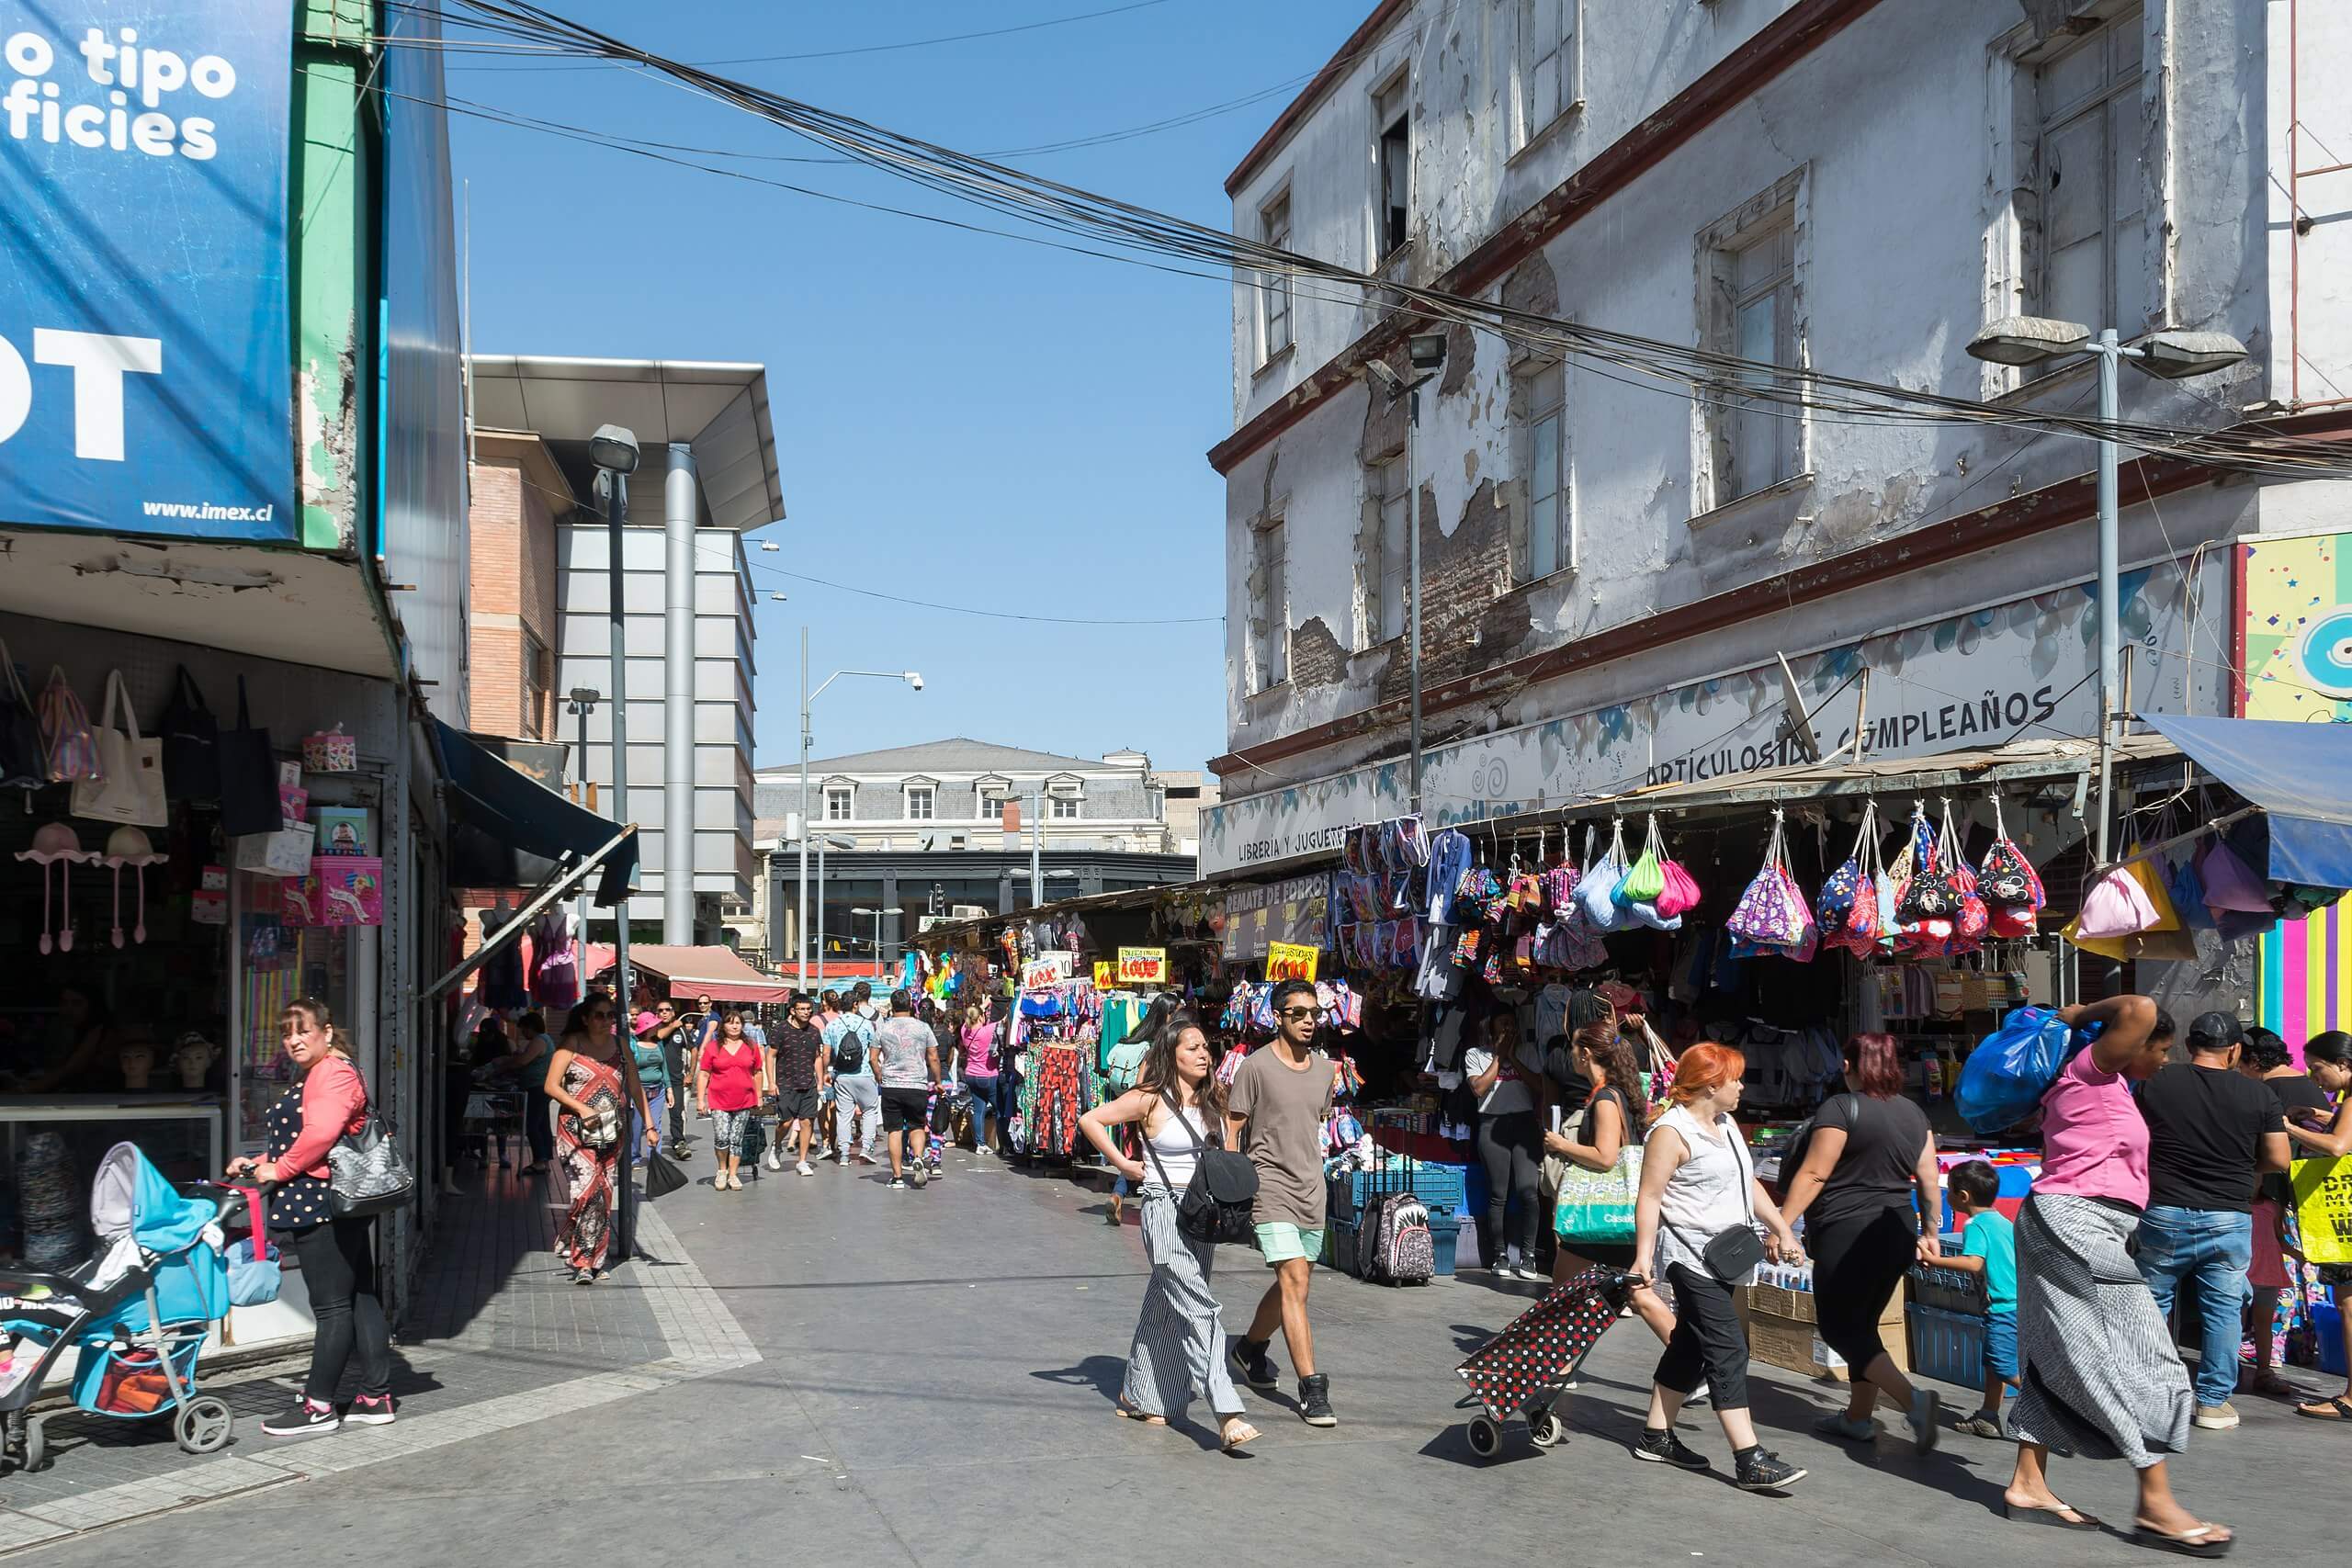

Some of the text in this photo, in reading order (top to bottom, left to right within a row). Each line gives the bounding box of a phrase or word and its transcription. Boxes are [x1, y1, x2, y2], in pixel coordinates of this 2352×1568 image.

[80, 28, 236, 107] tipo
[3, 79, 217, 161] ficies
[0, 327, 162, 461] T
[143, 502, 273, 522] www.imex.cl
[1238, 833, 1280, 862] LIBRERÍA
[1284, 835, 1291, 853] Y
[1226, 887, 1264, 914] REMATE
[1267, 885, 1281, 907] DE
[1283, 874, 1330, 903] FORROS
